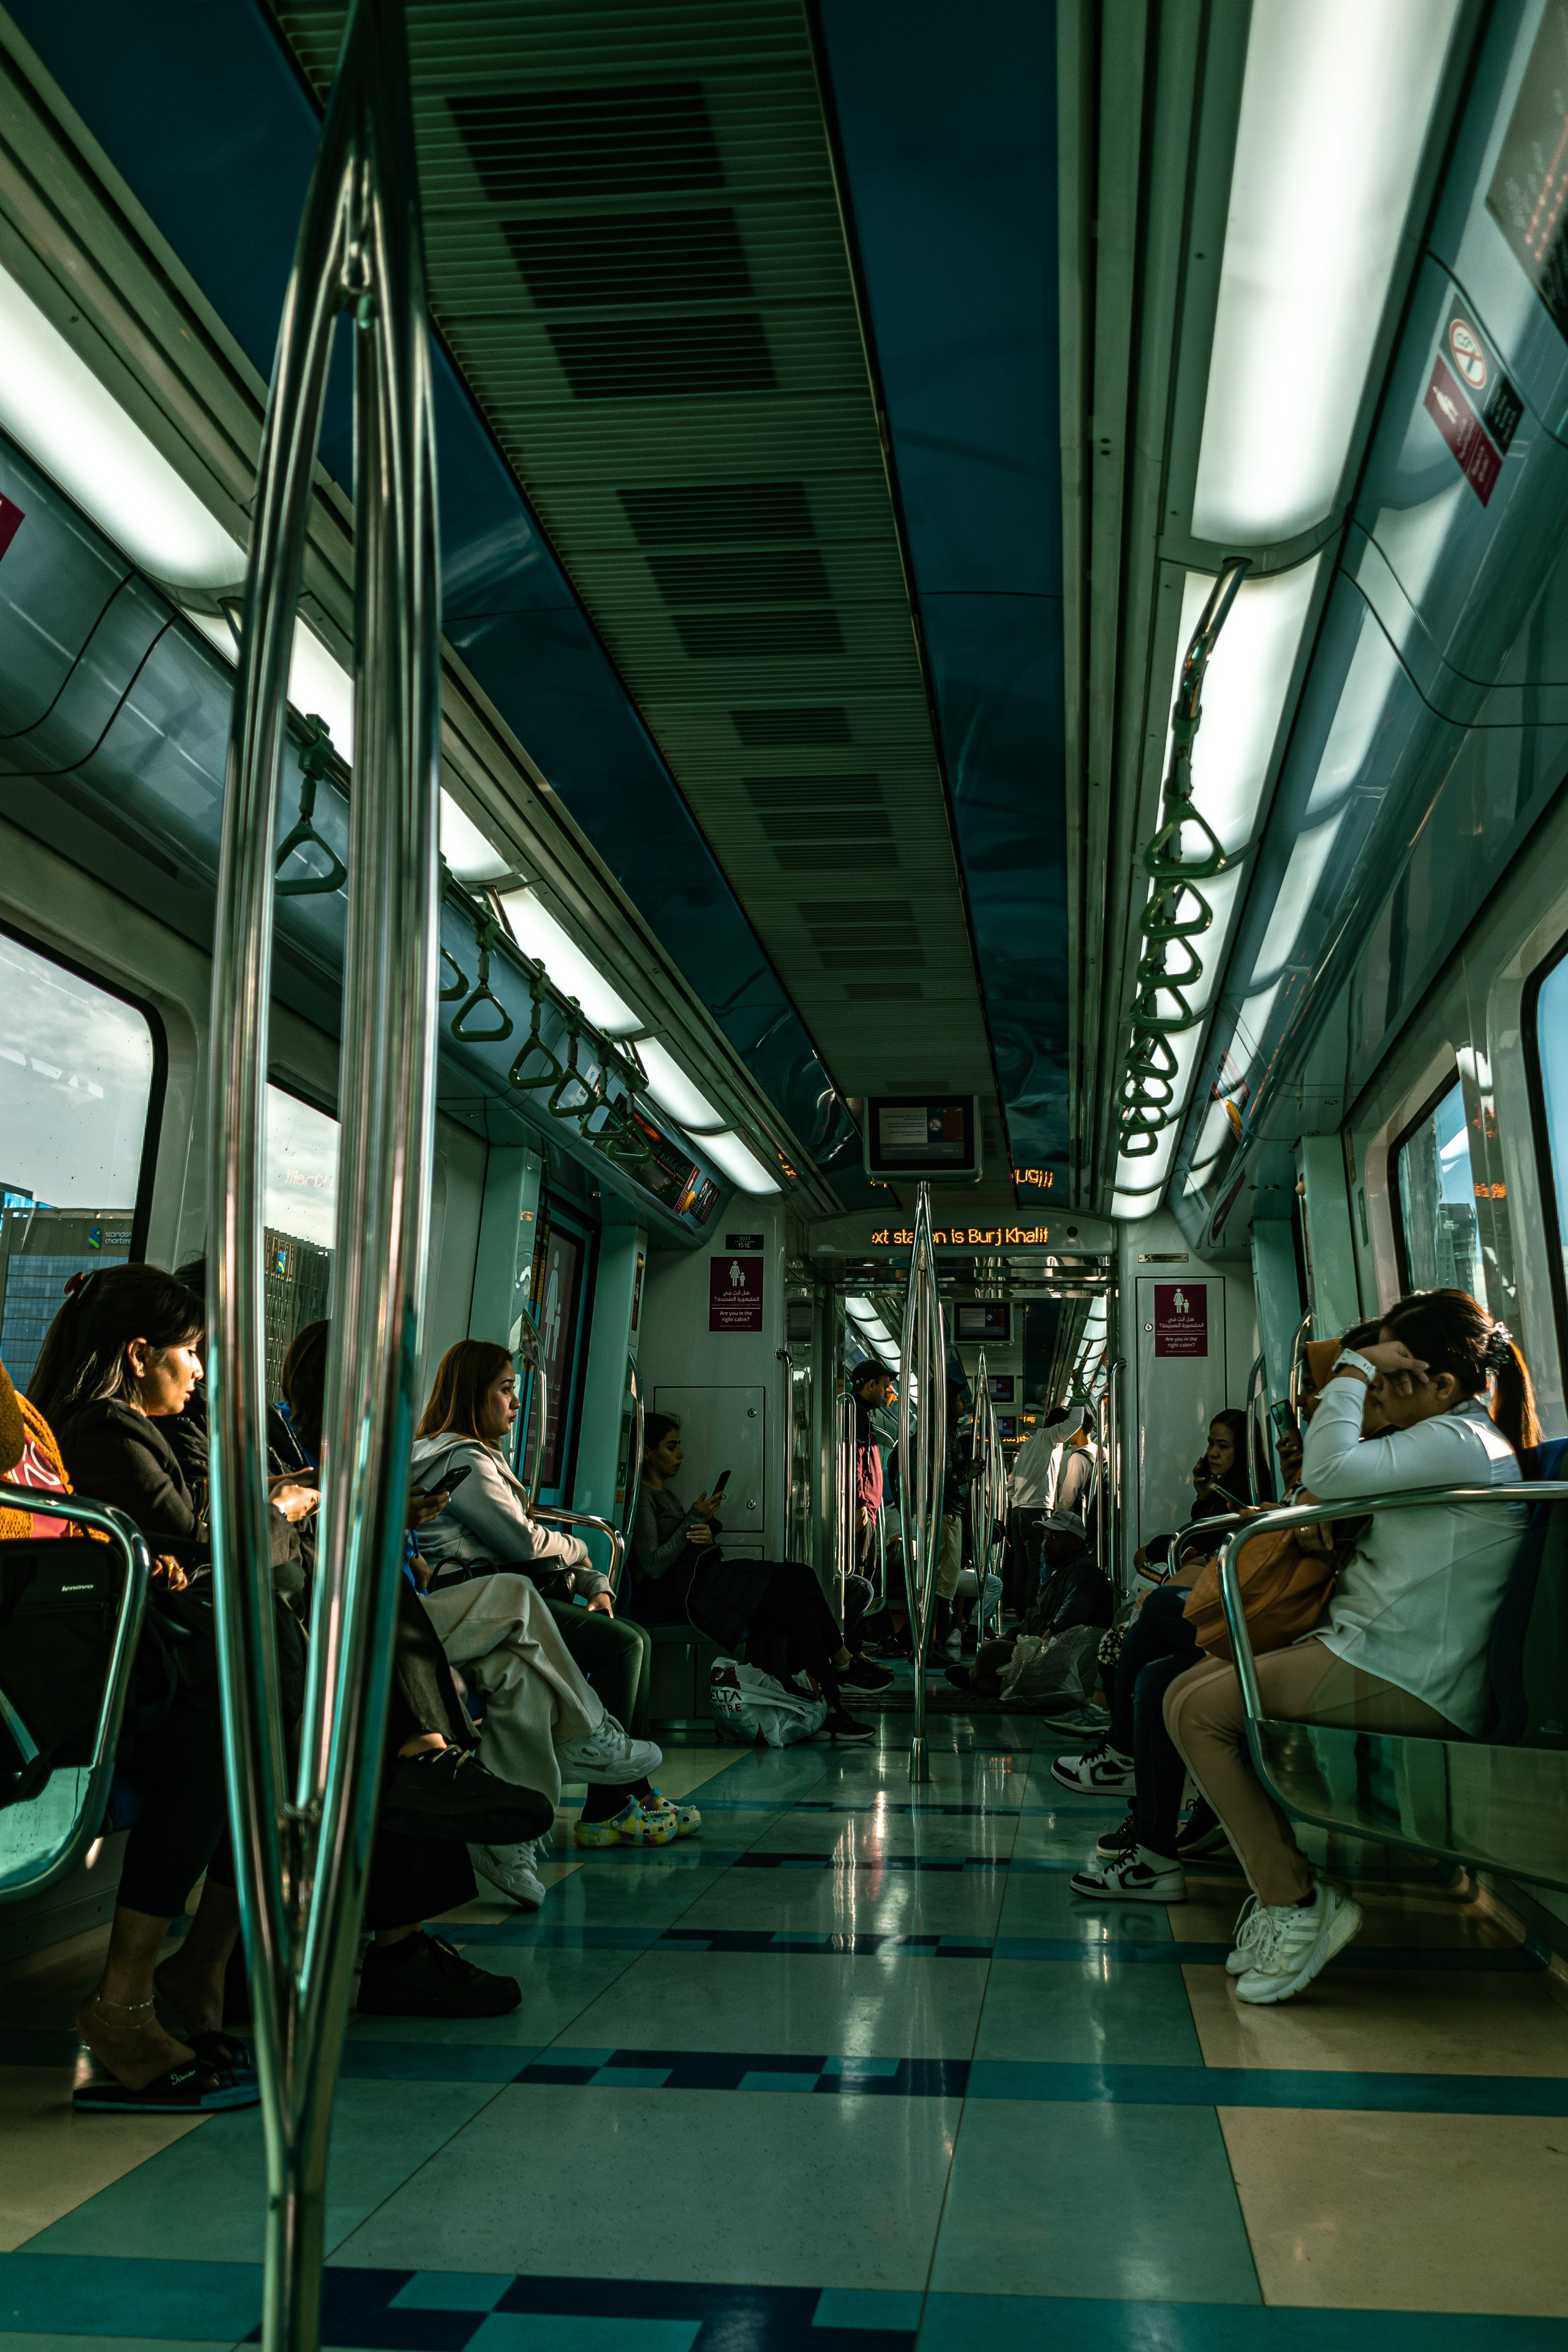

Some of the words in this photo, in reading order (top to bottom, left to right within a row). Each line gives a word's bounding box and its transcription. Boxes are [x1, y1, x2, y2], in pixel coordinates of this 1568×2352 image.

[951, 1229, 965, 1243] is
[968, 1228, 1001, 1246] Burj
[710, 1689, 742, 1702] ELTA
